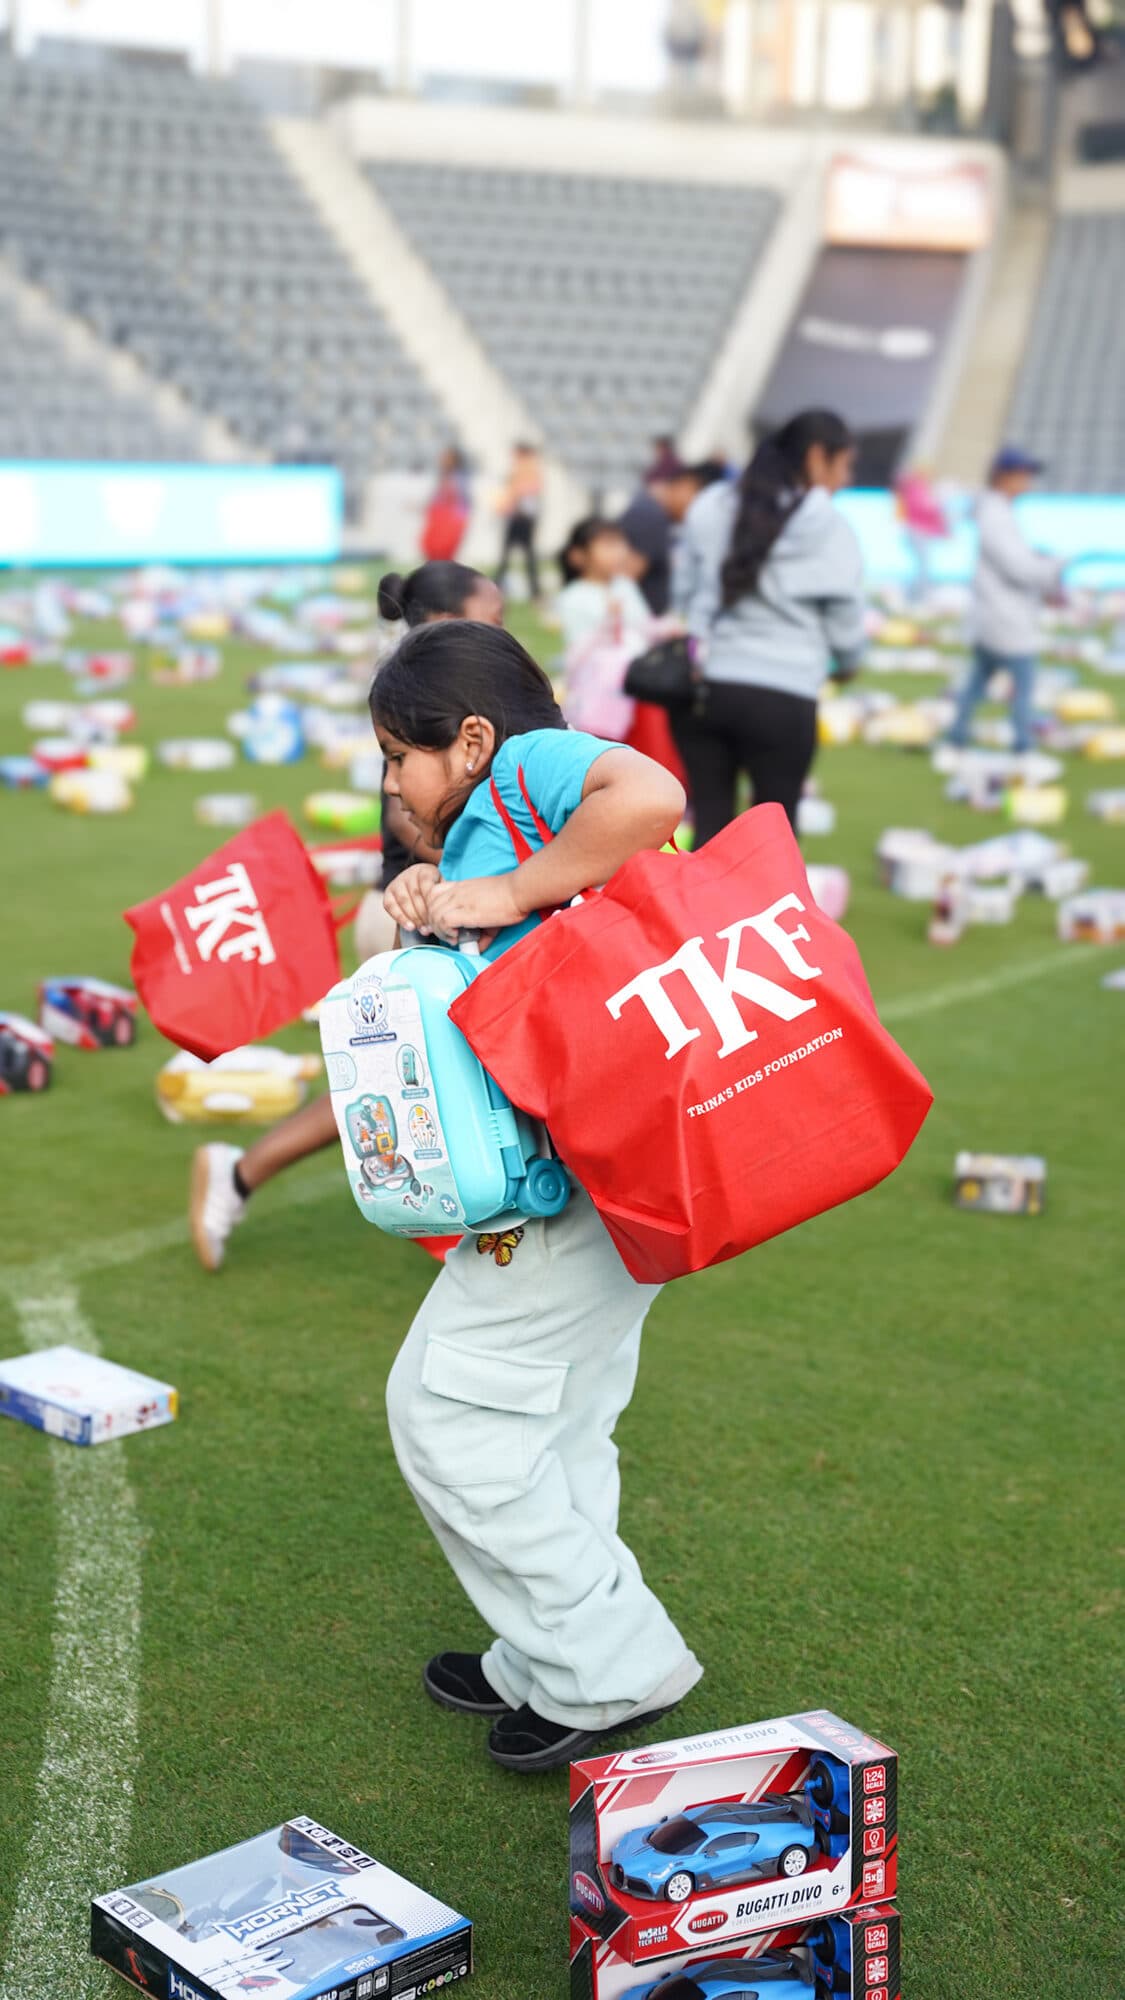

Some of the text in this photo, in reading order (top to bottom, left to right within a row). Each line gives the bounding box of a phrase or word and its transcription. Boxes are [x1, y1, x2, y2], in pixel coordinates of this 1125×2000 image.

[184, 862, 276, 965] TKF
[604, 891, 824, 1061] TKF
[686, 1027, 844, 1118] TRINA'S KIDS FOUNDATION
[682, 1727, 778, 1753] BUGATTI DIVO
[866, 1769, 883, 1782] 1:24
[866, 1781, 883, 1790] SCALE
[575, 1879, 602, 1911] BUGATTI
[832, 1884, 845, 1896] 6+
[736, 1884, 822, 1918] BUGATTI DIVO
[225, 1883, 341, 1939] HORNET
[692, 1914, 724, 1929] BUGATTI
[638, 1925, 668, 1940] WORLD
[638, 1933, 668, 1947] TECH TOYS
[867, 1929, 885, 1941] 1:24
[867, 1941, 885, 1949] SCALE
